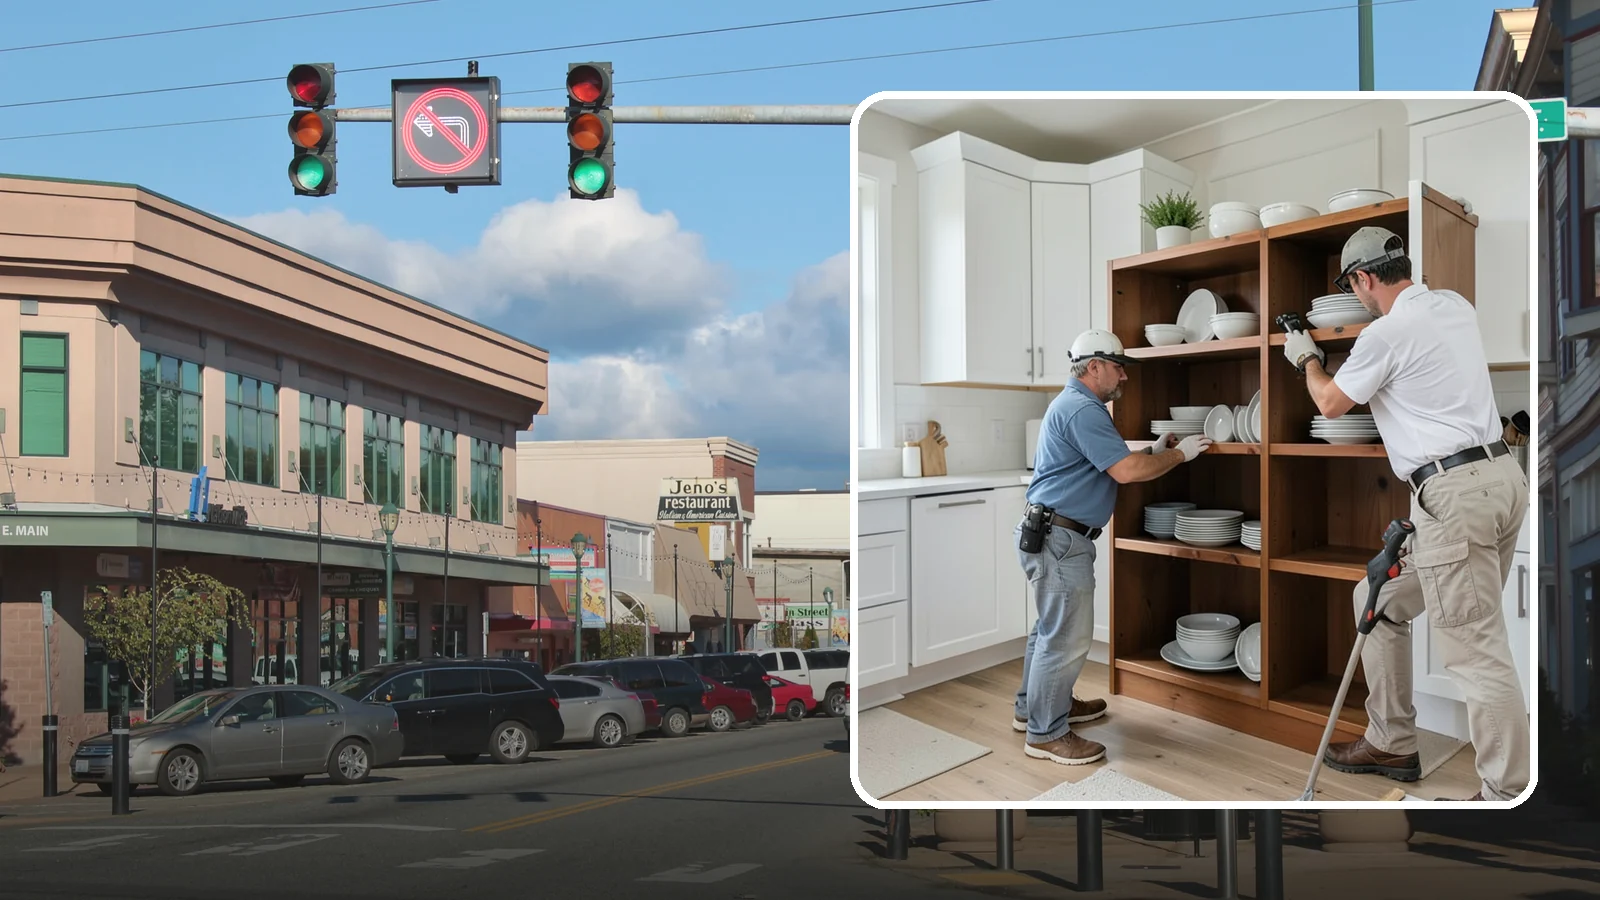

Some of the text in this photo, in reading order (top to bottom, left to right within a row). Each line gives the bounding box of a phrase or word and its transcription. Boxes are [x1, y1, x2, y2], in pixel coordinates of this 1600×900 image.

[670, 480, 728, 494] Jeno's
[665, 496, 731, 509] restaurant
[658, 510, 681, 519] Italian
[686, 510, 714, 519] American
[715, 510, 738, 519] Cuisine
[2, 525, 49, 536] E. MAIN
[797, 608, 829, 617] Street
[790, 619, 823, 627] lass
